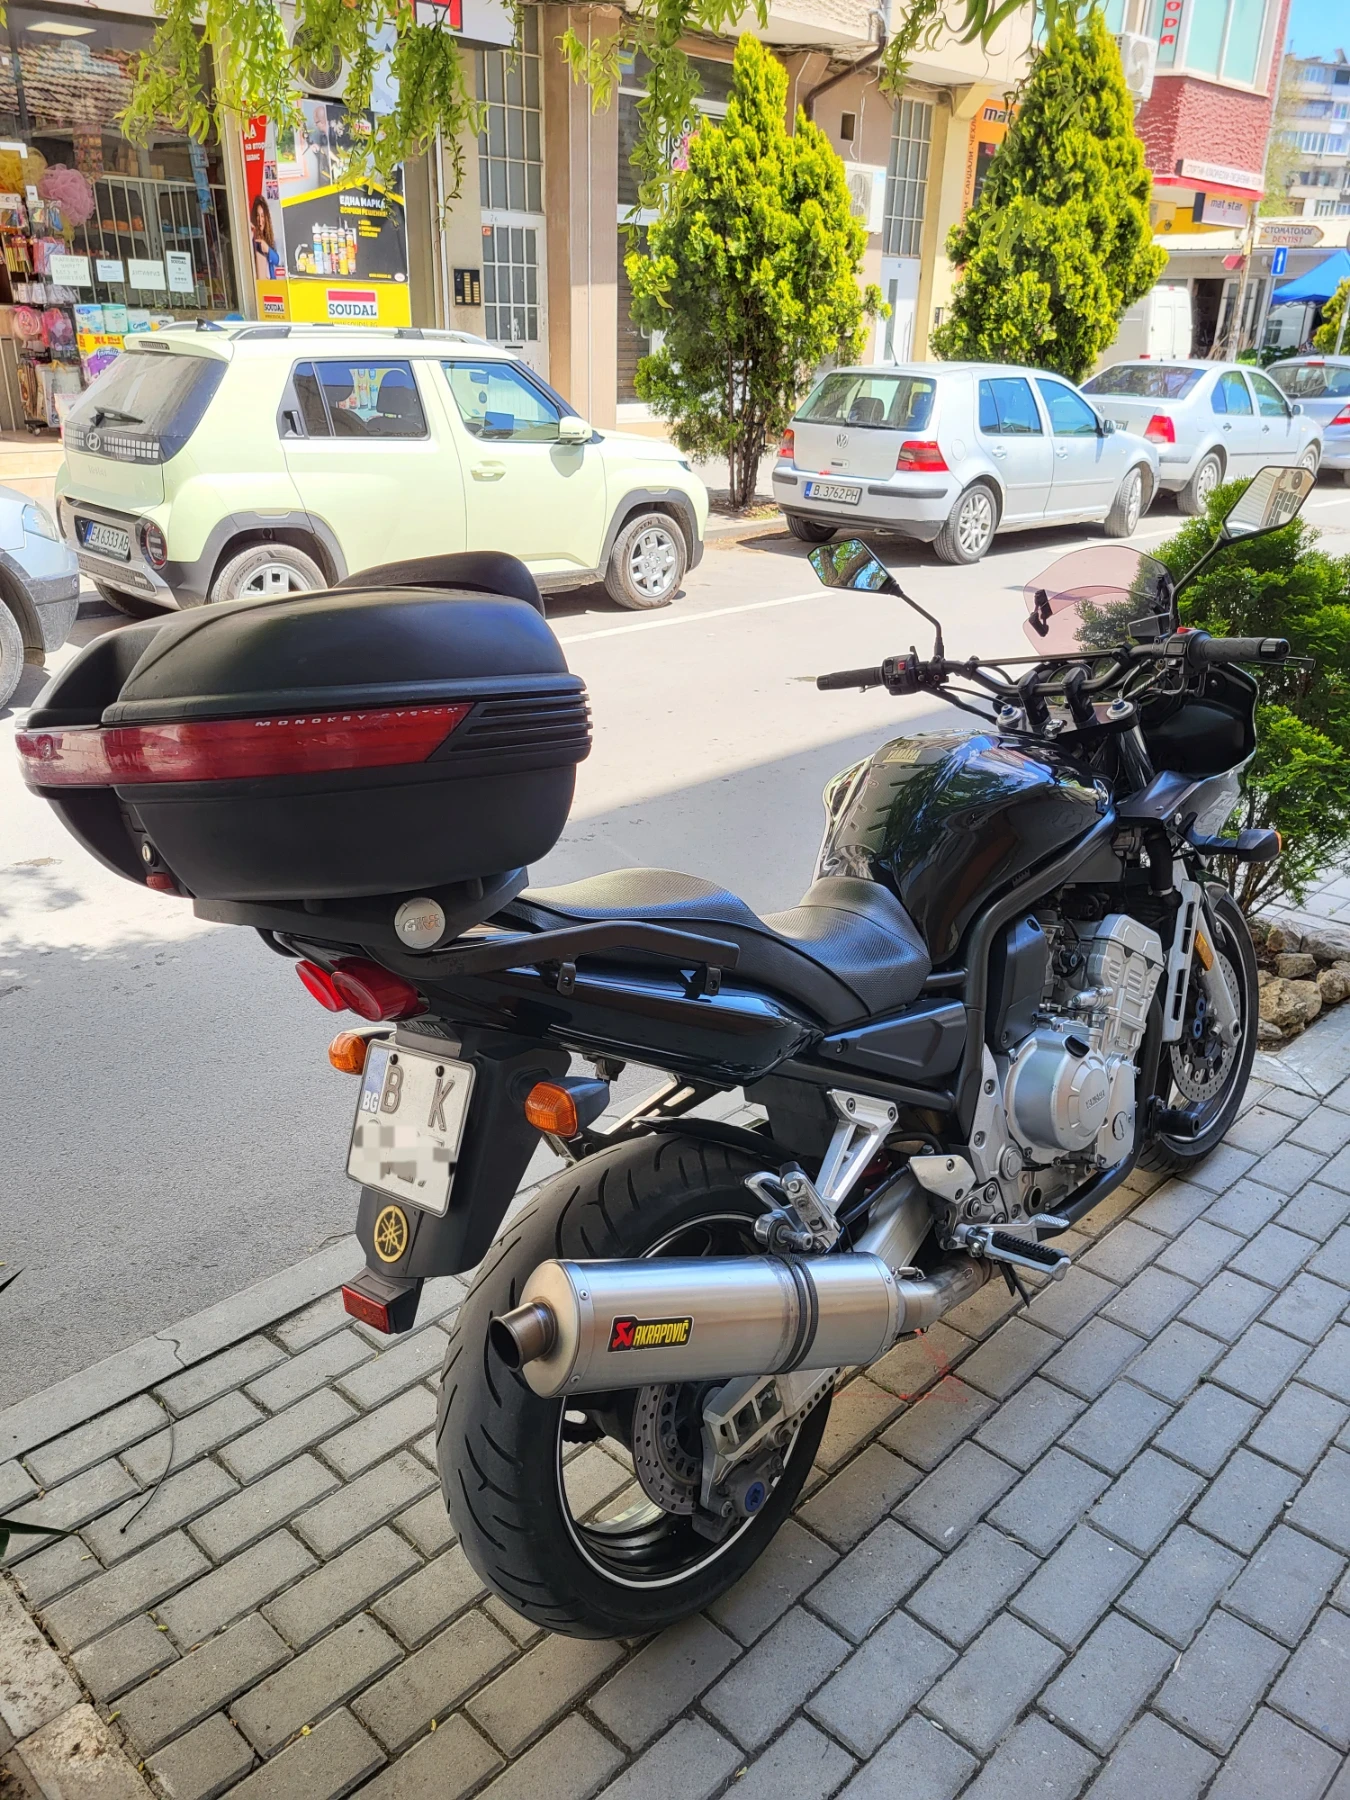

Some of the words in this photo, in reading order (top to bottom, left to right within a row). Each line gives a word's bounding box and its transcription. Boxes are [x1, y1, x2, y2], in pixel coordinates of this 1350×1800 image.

[339, 195, 361, 207] ЕДНА
[1210, 199, 1226, 209] mat
[1227, 201, 1243, 211] star
[1264, 226, 1315, 236] СТОМАТОЛОГ
[1272, 235, 1304, 244] DENTIST
[264, 303, 285, 312] SOUDAL
[328, 303, 377, 316] SOUDAL
[94, 336, 107, 345] XL
[362, 1091, 380, 1113] BG
[380, 1065, 404, 1115] B
[427, 1078, 455, 1132] K
